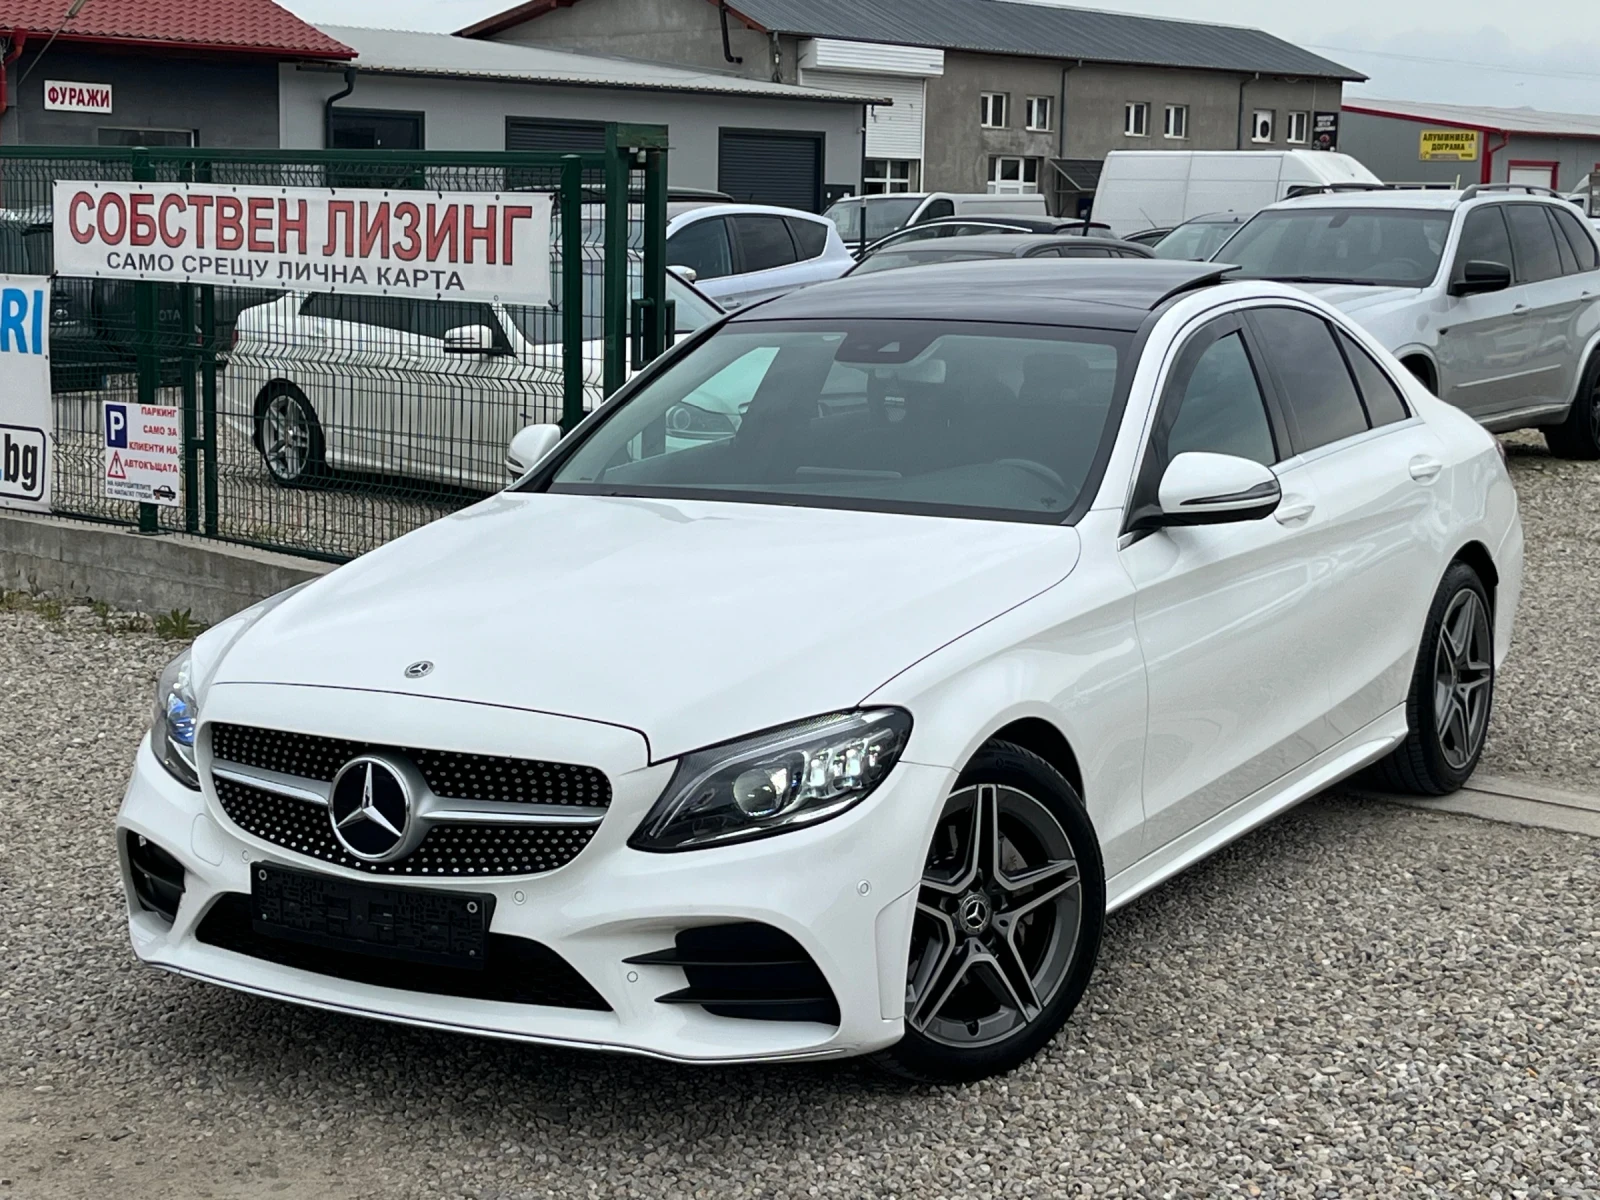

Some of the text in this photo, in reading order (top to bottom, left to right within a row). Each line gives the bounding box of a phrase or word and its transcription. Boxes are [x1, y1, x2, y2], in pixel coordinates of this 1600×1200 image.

[48, 86, 109, 108] ФУРАЖИ
[1423, 133, 1475, 142] АЛУМИНИЕВА
[1431, 143, 1466, 151] ДОГРАМА
[69, 191, 532, 265] СОБСТВЕН ЛИЗИНГ
[107, 251, 465, 291] САМО СРЕЩУ ЛИЧНА КАРТА
[141, 406, 177, 418] ПАРКИНГ
[110, 411, 124, 440] P
[143, 425, 177, 436] САМО ЗА
[128, 441, 178, 454] КЛИЕНТИ НА
[0, 433, 38, 491] bg
[124, 459, 178, 473] АВТОКЪЩАТА
